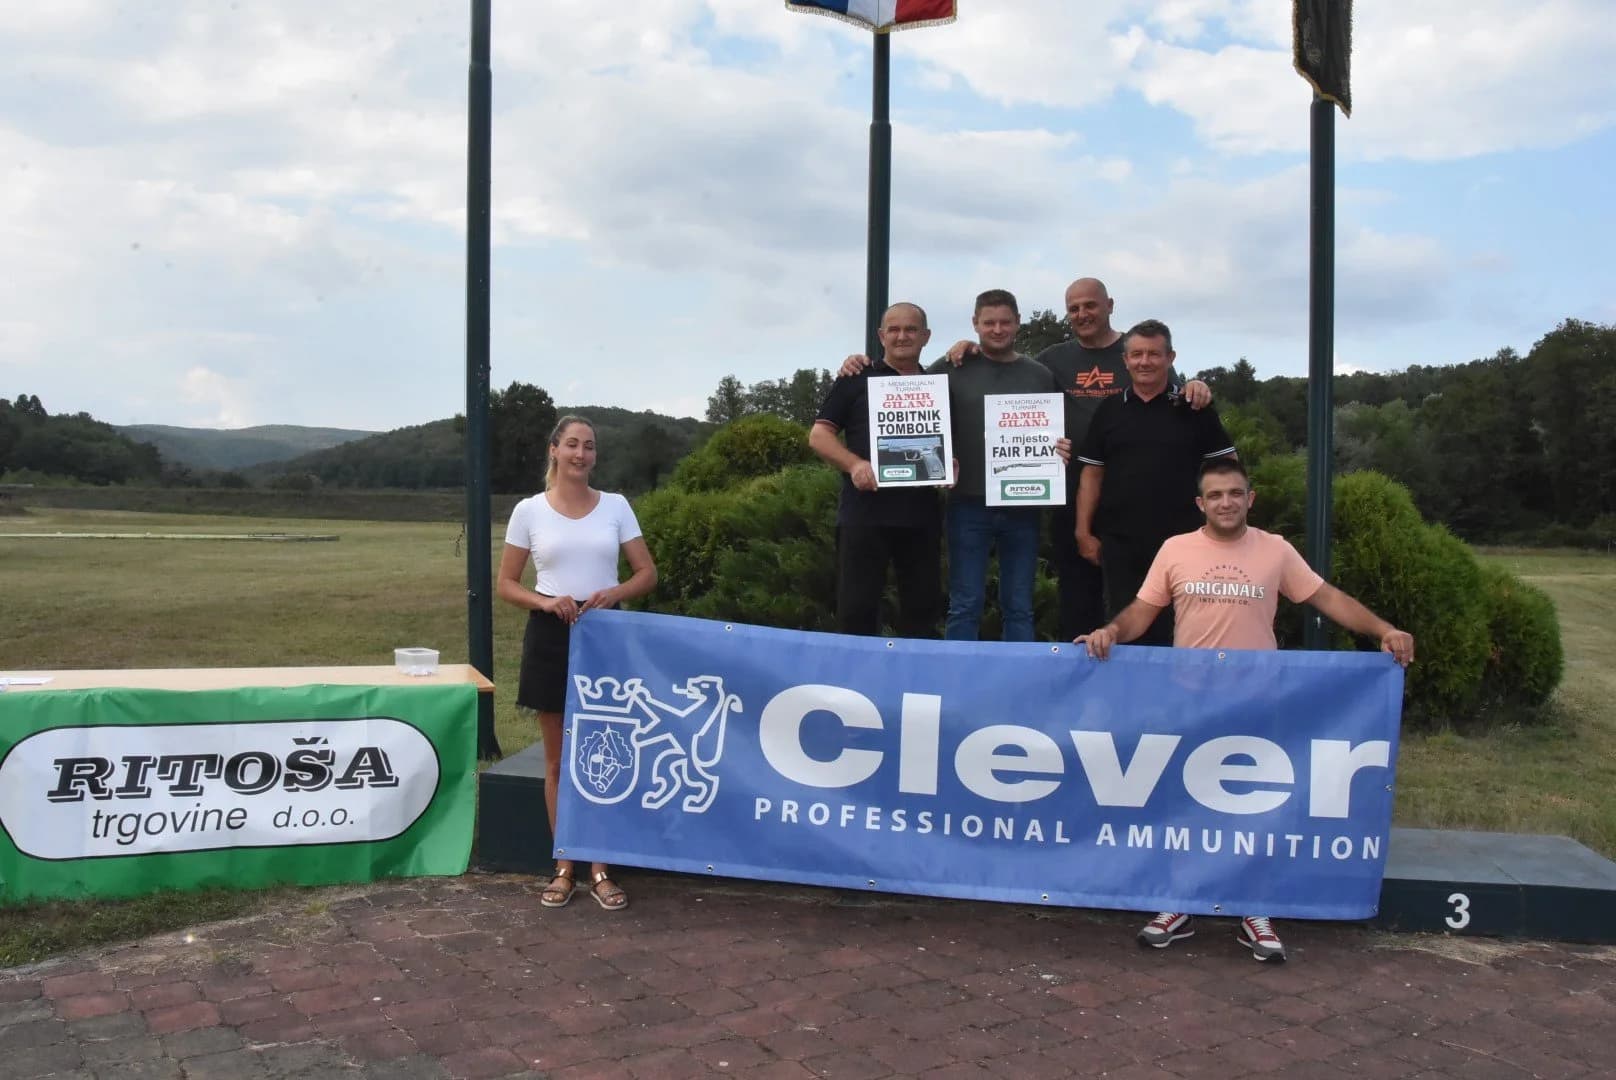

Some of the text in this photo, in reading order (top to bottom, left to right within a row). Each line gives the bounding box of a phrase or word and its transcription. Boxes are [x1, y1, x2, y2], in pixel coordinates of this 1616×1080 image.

[886, 392, 931, 401] DAMIR
[882, 400, 935, 409] GILANJ
[878, 409, 942, 422] DOBITNIK
[1002, 411, 1046, 420] DAMIR
[878, 422, 941, 435] TOMBOLE
[998, 419, 1050, 428] GILANJ
[1000, 434, 1050, 445] 1. mjesto
[992, 445, 1056, 458] FAIR PLAY
[1184, 582, 1265, 599] ORIGINALS
[759, 684, 1390, 819] Clever
[47, 737, 399, 803] RITOŠA
[92, 803, 355, 845] trgovine d.o.o.
[754, 797, 1380, 860] PROFESSIONAL AMMUNITION
[1445, 893, 1471, 929] 3
